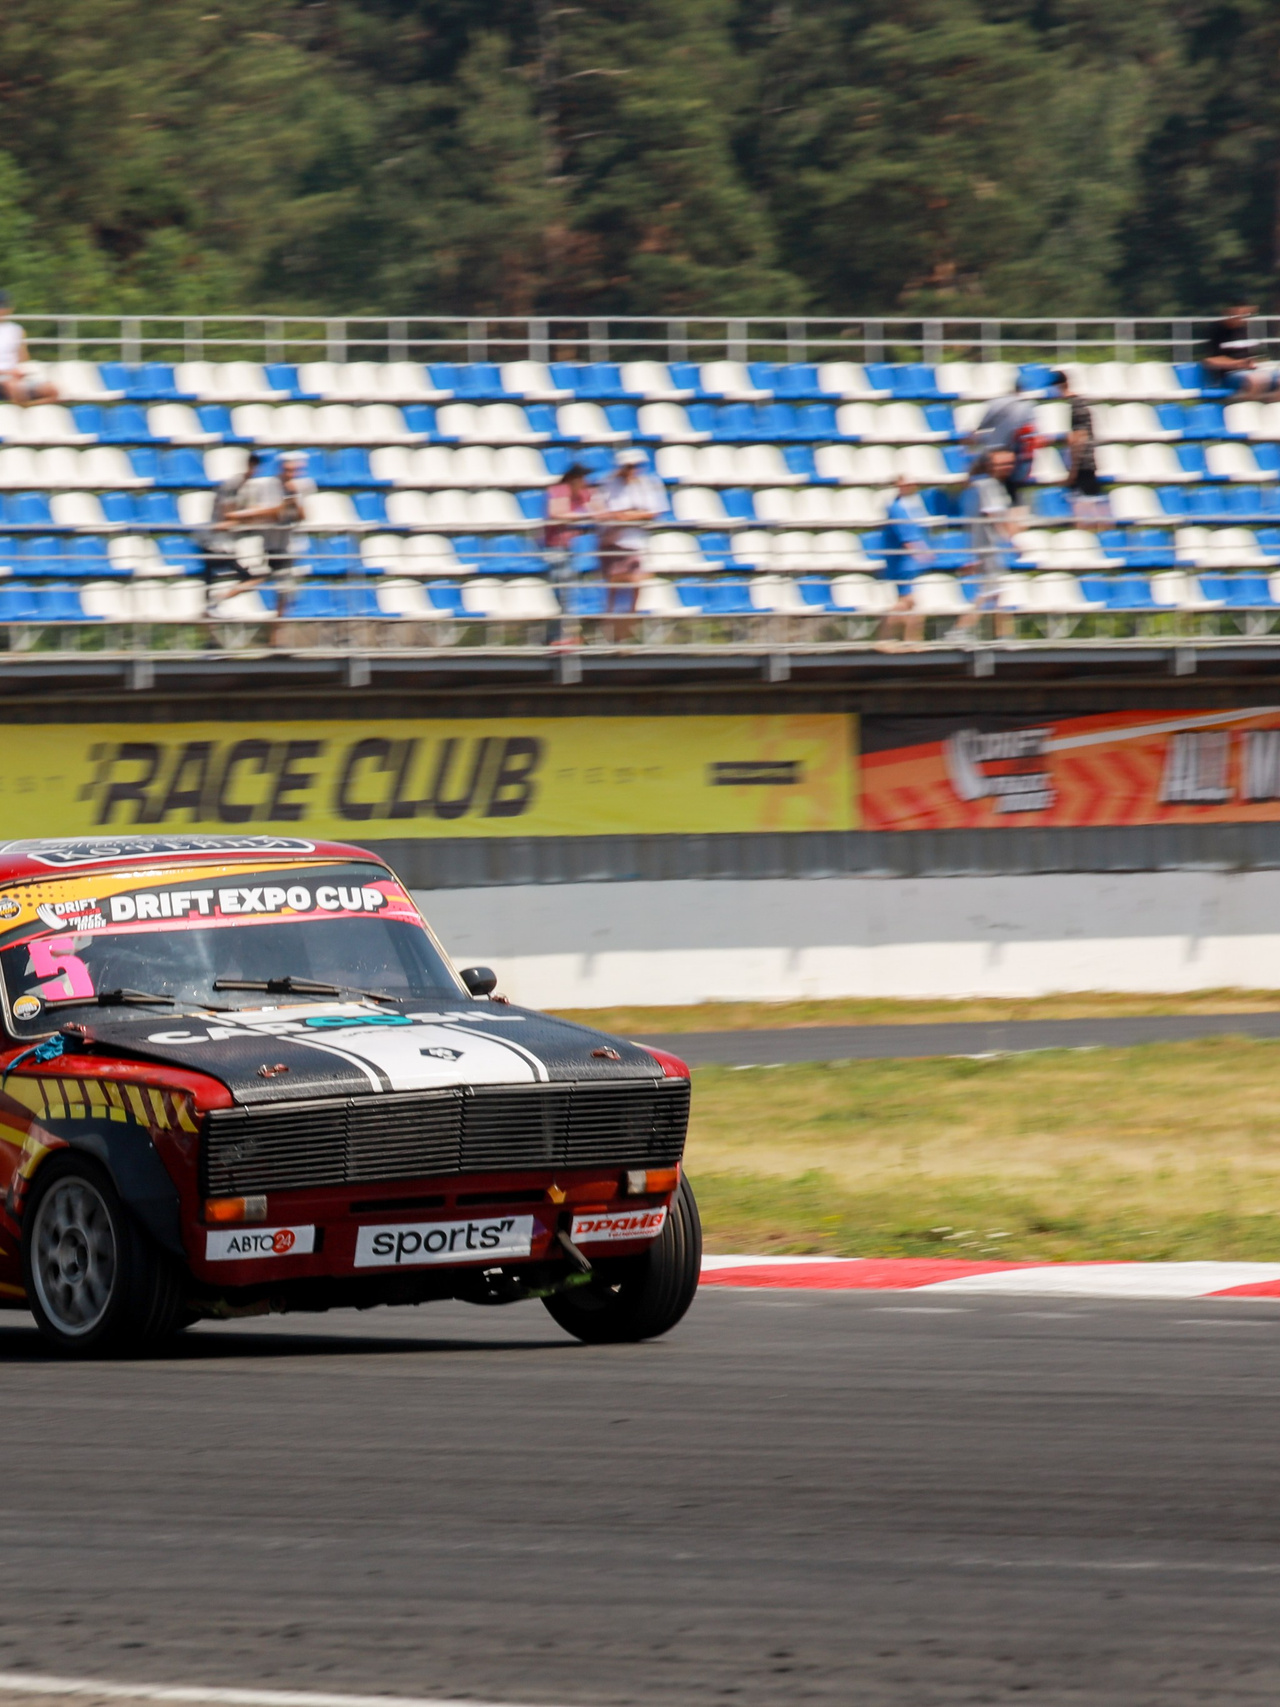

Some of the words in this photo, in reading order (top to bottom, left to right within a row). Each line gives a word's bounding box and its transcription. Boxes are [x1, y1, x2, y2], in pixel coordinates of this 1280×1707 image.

[92, 738, 326, 824] RACE
[335, 736, 546, 820] CLUB
[54, 898, 97, 915] DRIFT
[110, 890, 215, 921] DRIFT
[219, 886, 312, 913] EXPO
[315, 886, 385, 912] CUP
[27, 936, 95, 1002] 5
